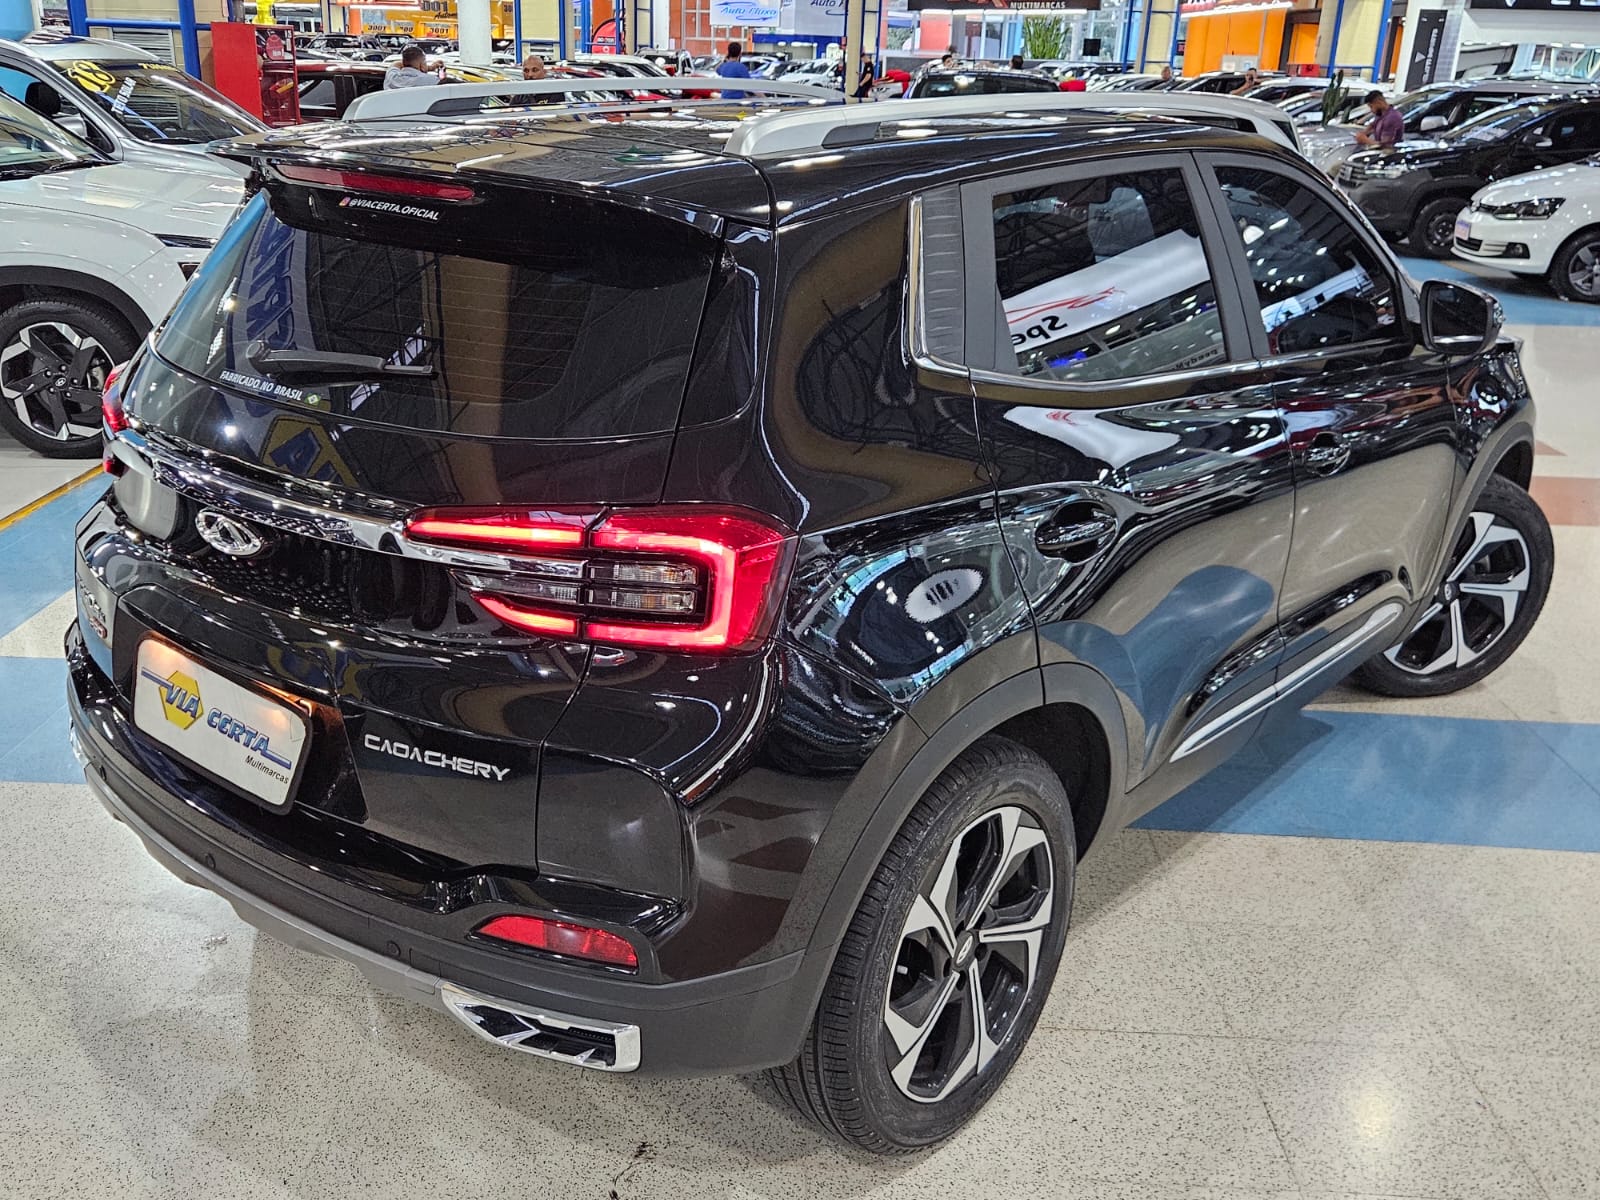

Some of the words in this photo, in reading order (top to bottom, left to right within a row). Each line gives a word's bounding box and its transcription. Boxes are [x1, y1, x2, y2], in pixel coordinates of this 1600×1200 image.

[721, 6, 745, 15] Auto
[349, 198, 440, 221] @VIACERTA.OFICIAL
[220, 370, 260, 389] FABRICADO
[260, 381, 274, 393] NO
[274, 385, 303, 401] BRASIL
[166, 683, 201, 719] VIA
[207, 707, 270, 754] CERTA
[245, 754, 289, 785] Multimarcas
